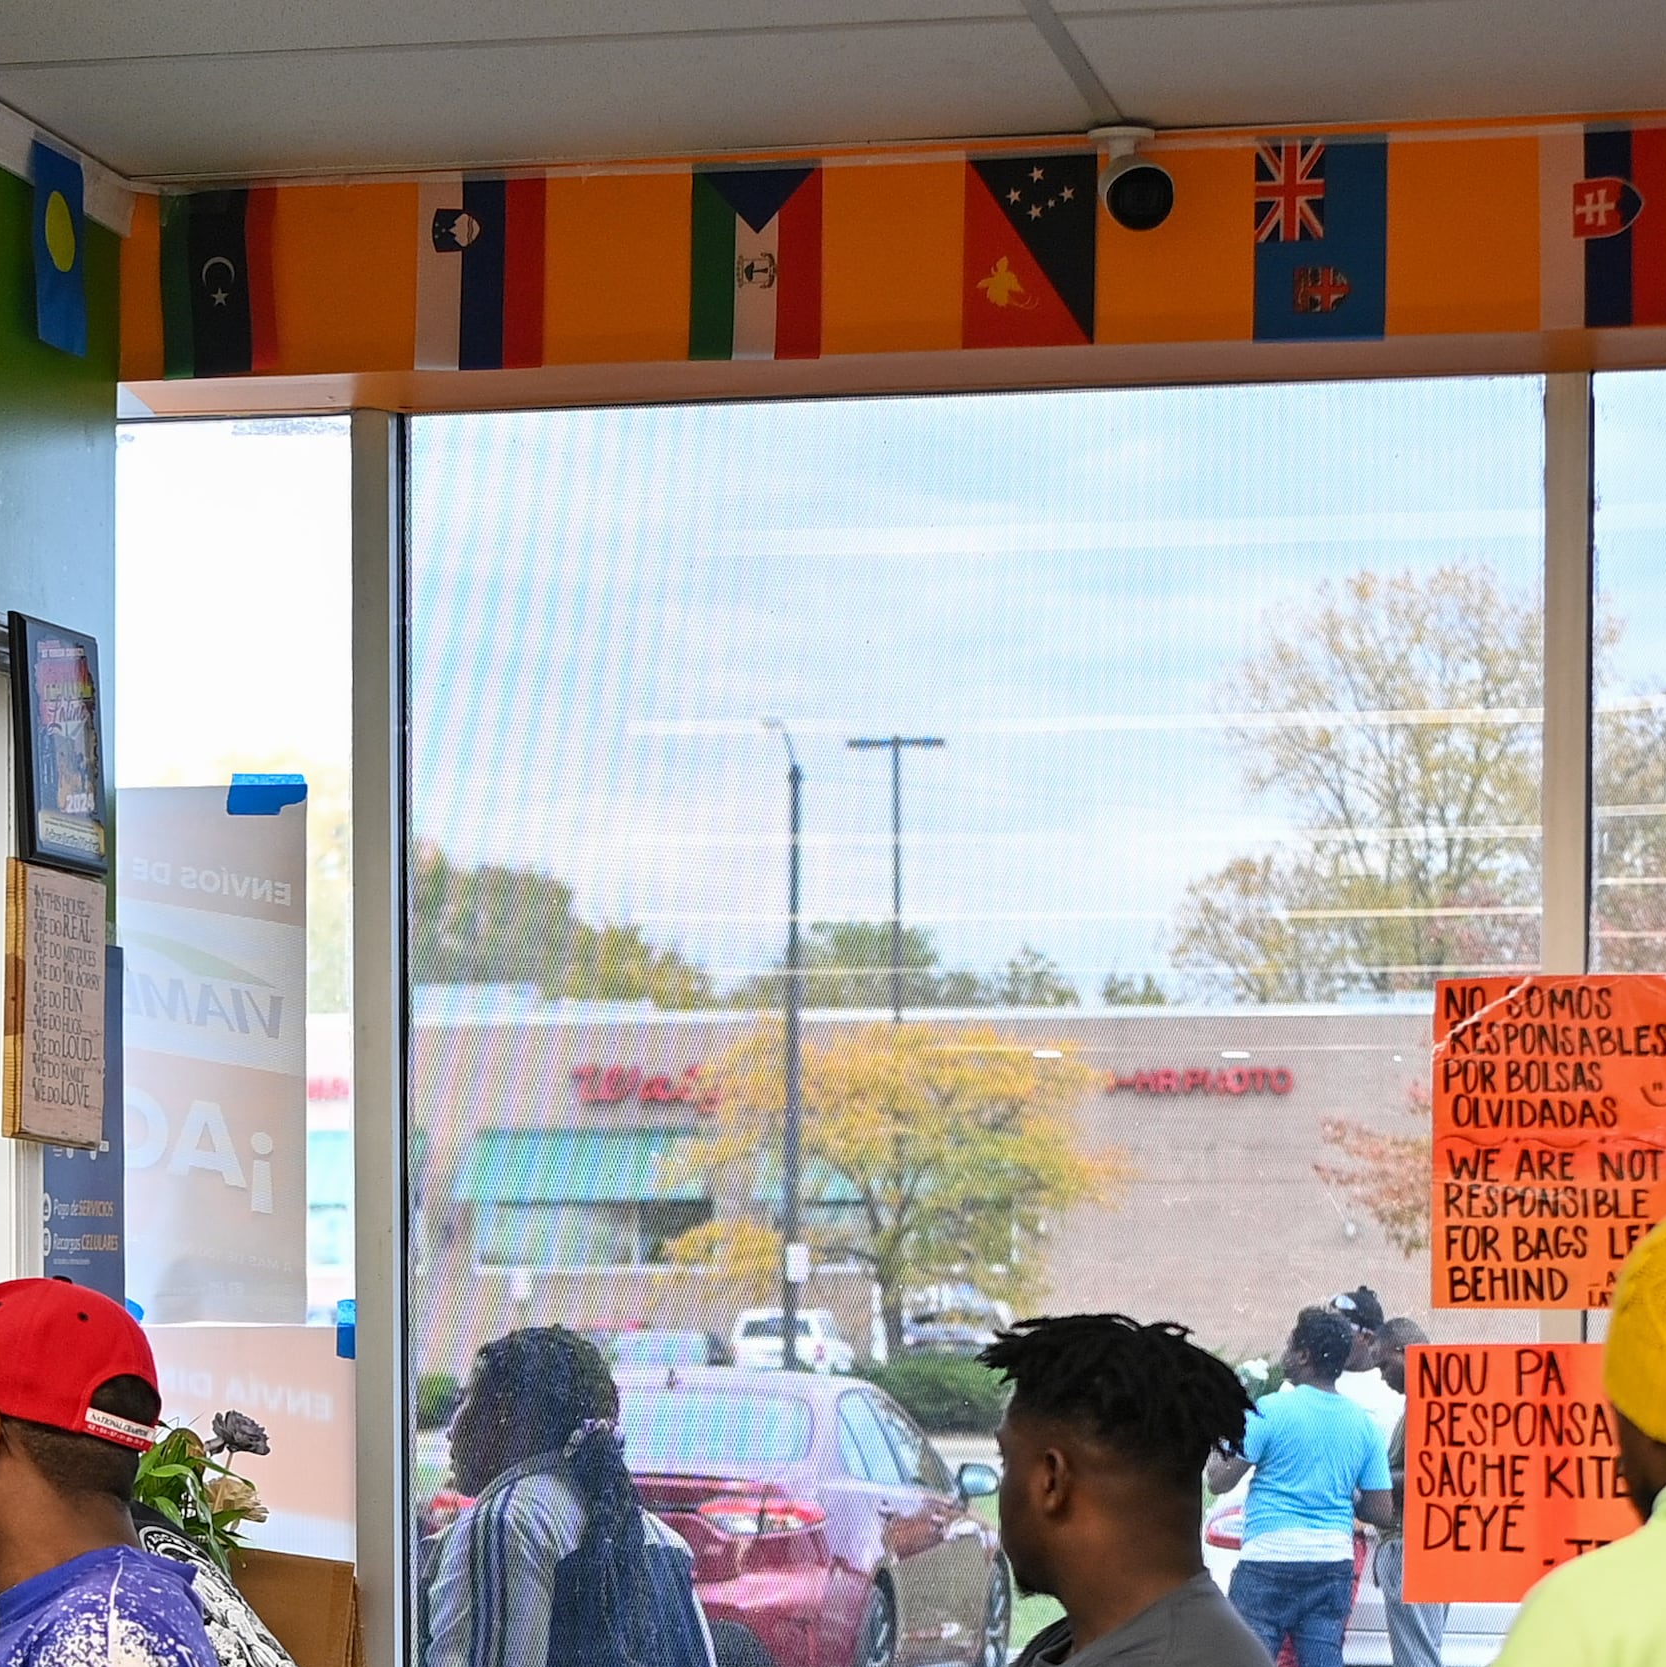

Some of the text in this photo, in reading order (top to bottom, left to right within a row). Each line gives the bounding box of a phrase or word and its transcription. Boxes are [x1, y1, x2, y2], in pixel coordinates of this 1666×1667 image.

[1444, 986, 1613, 1021] NO SOMOS
[1443, 1059, 1603, 1093] POR BOLSAS
[1451, 1096, 1617, 1129] OLVIDADAS
[1446, 1148, 1666, 1183] WE ARE NOT
[1444, 1183, 1650, 1219] RESPONSIBLE
[1445, 1224, 1588, 1262] FOR BAGS
[1449, 1266, 1568, 1302] BEHIND
[1419, 1349, 1566, 1399] NOU PA
[1416, 1451, 1530, 1500] SACHE
